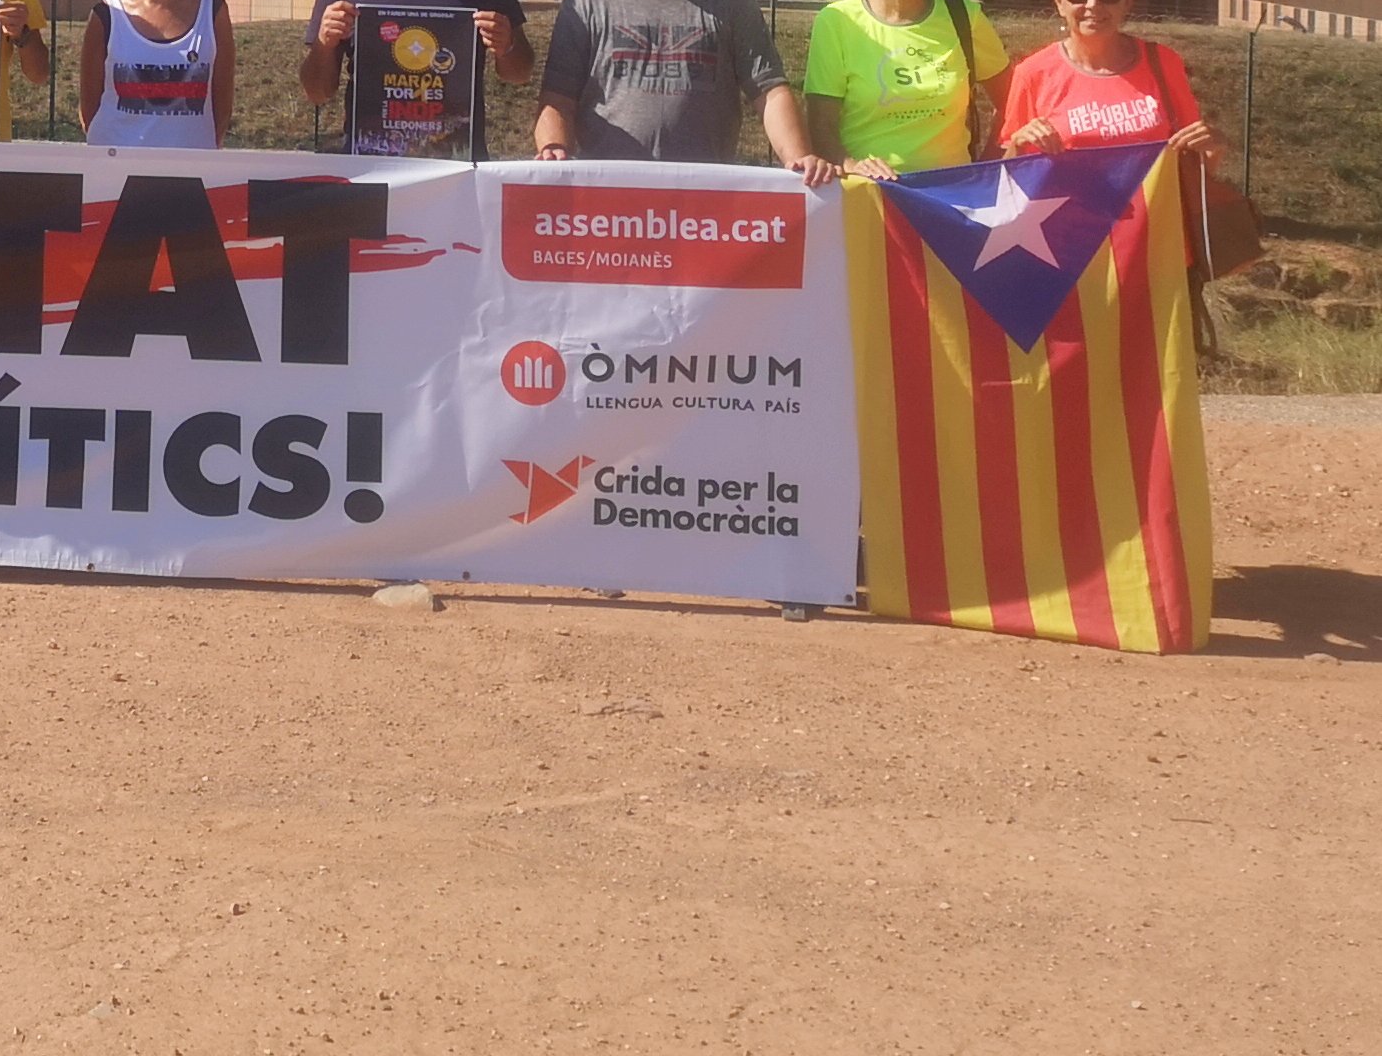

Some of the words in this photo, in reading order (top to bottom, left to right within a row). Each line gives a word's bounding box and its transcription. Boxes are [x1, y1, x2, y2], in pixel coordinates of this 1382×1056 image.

[894, 66, 922, 85] Sí
[382, 120, 442, 131] LLEDONERS
[1068, 95, 1158, 136] REPÚBLICA
[534, 209, 786, 243] assemblea.cat
[533, 250, 673, 270] BAGES/MOIANÈS
[581, 343, 801, 387] ÒMNIUM
[586, 397, 663, 410] LLENGUA
[672, 397, 755, 412] CULTURA
[765, 398, 801, 413] PAÍS
[594, 465, 685, 496] Crida
[698, 478, 758, 506] per
[768, 472, 798, 504] la
[593, 497, 798, 536] Democràcia
